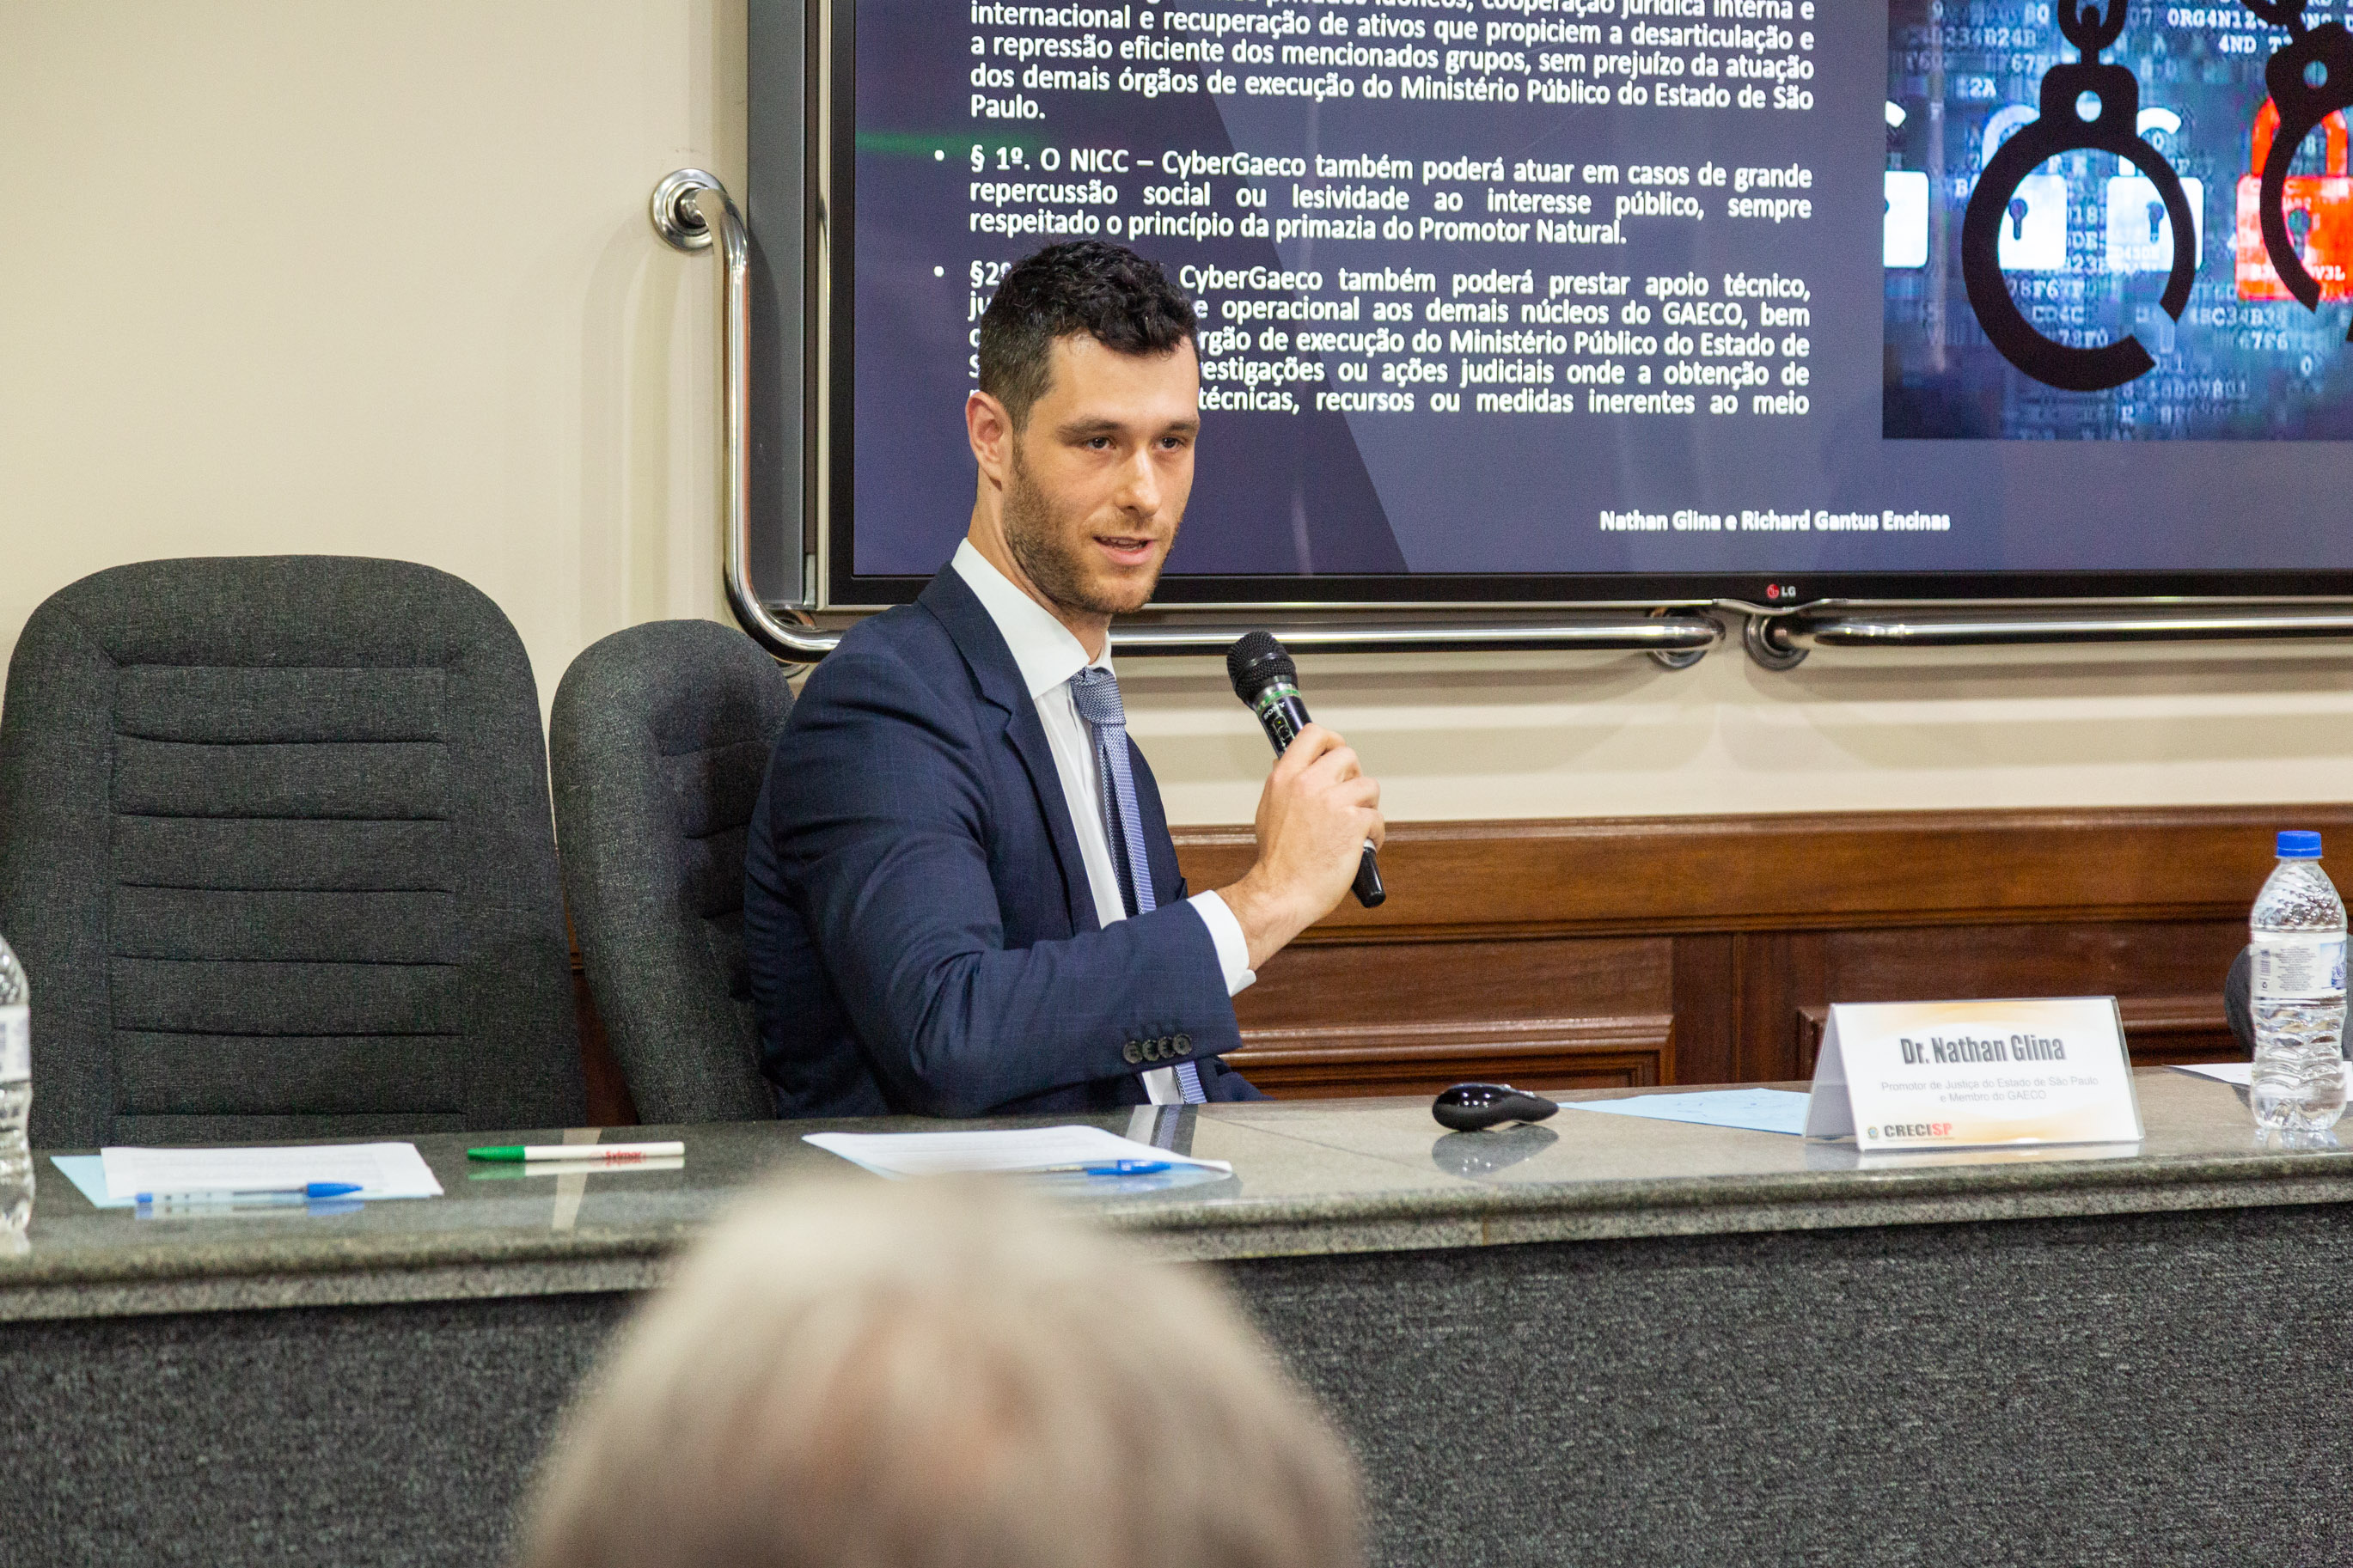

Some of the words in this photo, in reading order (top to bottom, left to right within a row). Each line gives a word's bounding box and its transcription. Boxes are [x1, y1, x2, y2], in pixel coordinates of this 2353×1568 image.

[1713, 0, 1794, 20] interna
[1800, 1, 1815, 21] e
[971, 1, 1130, 29] internacional
[1140, 10, 1155, 29] e
[1164, 9, 1311, 40] recuperação
[1318, 10, 1349, 36] de
[1356, 12, 1427, 39] ativos
[1433, 20, 1479, 46] que
[1486, 17, 1602, 48] propiciem
[1609, 25, 1623, 45] a
[1630, 20, 1794, 55] desarticulação
[1800, 31, 1815, 51] e
[970, 35, 985, 55] a
[993, 33, 1113, 63] repressão
[1120, 34, 1225, 63] eficiente
[1232, 38, 1274, 64] dos
[1281, 41, 1439, 69] mencionados
[1445, 50, 1531, 76] grupos,
[1538, 52, 1586, 73] sem
[1593, 49, 1685, 81] prejuízo
[1690, 52, 1719, 77] da
[1725, 53, 1815, 85] atuação
[970, 62, 1015, 88] dos
[1023, 64, 1110, 90] demais
[1118, 66, 1199, 98] órgãos
[1207, 68, 1237, 95] de
[1244, 71, 1355, 103] execução
[1362, 73, 1394, 99] do
[1401, 74, 1519, 102] Ministério
[1527, 77, 1611, 105] Público
[1617, 80, 1648, 106] do
[1655, 82, 1732, 108] Estado
[1737, 83, 1767, 109] de
[1773, 84, 1814, 110] São
[971, 93, 1046, 119] Paulo.
[970, 144, 985, 173] §
[1040, 147, 1060, 171] O
[1070, 148, 1129, 173] NICC
[1162, 149, 1306, 180] CyberGaeco
[1314, 153, 1414, 180] também
[1422, 155, 1505, 186] poderá
[1513, 158, 1575, 183] atuar
[1582, 164, 1620, 185] em
[1627, 165, 1690, 186] casos
[1697, 161, 1727, 186] de
[1733, 162, 1813, 193] grande
[970, 179, 1118, 208] repercussão
[1143, 180, 1211, 206] social
[1236, 187, 1267, 208] ou
[1293, 183, 1410, 210] lesividade
[1433, 192, 1464, 211] ao
[1487, 187, 1592, 215] interesse
[1615, 190, 1705, 221] público,
[1727, 198, 1812, 224] sempre
[969, 208, 1100, 239] respeitado
[1106, 215, 1122, 235] o
[1128, 210, 1234, 242] princípio
[1240, 212, 1269, 237] da
[1275, 213, 1376, 244] primazia
[1382, 215, 1414, 241] do
[1419, 217, 1531, 242] Promotor
[1537, 218, 1628, 245] Natural.
[1180, 264, 1323, 295] CyberGaeco
[1337, 266, 1436, 293] também
[1452, 268, 1534, 299] poderá
[1549, 271, 1631, 301] prestar
[1645, 271, 1709, 302] apoio
[1723, 272, 1811, 302] técnico,
[1221, 295, 1360, 326] operacional
[1372, 302, 1414, 321] aos
[1425, 296, 1509, 323] demais
[1521, 298, 1610, 324] núcleos
[1621, 299, 1652, 325] do
[1662, 301, 1748, 330] GAECO,
[1760, 301, 1811, 327] bem
[1197, 326, 1252, 357] rgão
[1259, 326, 1289, 351] de
[1296, 327, 1405, 358] execução
[1411, 327, 1443, 353] do
[1450, 328, 1568, 355] Ministério
[1574, 329, 1658, 356] Público
[1663, 331, 1695, 356] do
[1700, 332, 1775, 357] Estado
[1781, 332, 1811, 357] de
[1200, 356, 1325, 387] estigações
[1337, 362, 1368, 382] ou
[1381, 357, 1448, 388] ações
[1459, 357, 1555, 388] judiciais
[1567, 359, 1626, 385] onde
[1637, 364, 1652, 385] a
[1663, 359, 1769, 391] obtenção
[1781, 360, 1810, 387] de
[1197, 385, 1301, 415] técnicas,
[1316, 392, 1415, 412] recursos
[1430, 393, 1460, 412] ou
[1476, 387, 1574, 413] medidas
[1588, 387, 1696, 414] inerentes
[1709, 394, 1739, 414] ao
[1752, 389, 1810, 415] meio
[1600, 509, 1668, 531] Nathan
[1672, 509, 1721, 531] Glina
[1725, 515, 1738, 531] e
[1741, 509, 1811, 531] Richard
[1814, 510, 1879, 531] Gantus
[1882, 510, 1951, 531] Encinas
[1781, 585, 1796, 598] LG
[1263, 701, 1286, 720] SONY
[1900, 1037, 1930, 1065] Dr.
[1931, 1035, 2008, 1064] Nathan
[2010, 1034, 2067, 1062] Glina
[1881, 1081, 1927, 1092] Promotor
[1930, 1080, 1942, 1090] de
[1946, 1079, 1979, 1092] Justiça
[1983, 1078, 1995, 1089] do
[1997, 1077, 2032, 1089] Estado
[2034, 1077, 2046, 1087] de
[2048, 1075, 2069, 1087] São
[2070, 1075, 2099, 1086] Paulo
[1940, 1094, 1947, 1103] e
[1948, 1091, 1990, 1103] Membro
[1993, 1091, 2005, 1101] do
[2008, 1089, 2047, 1101] GAECO
